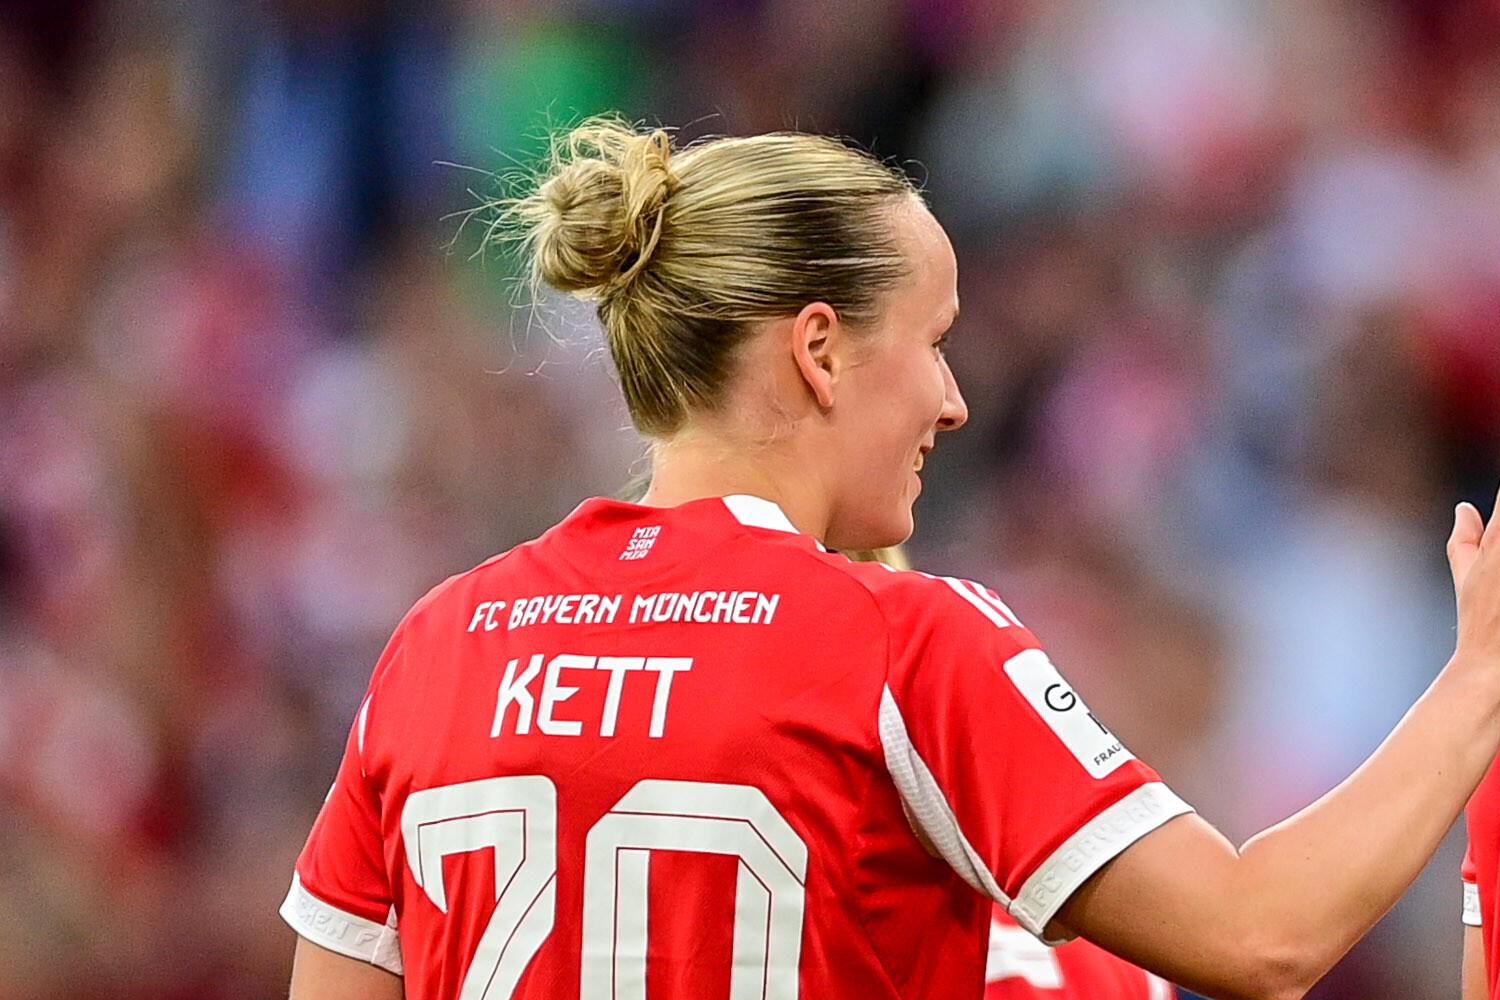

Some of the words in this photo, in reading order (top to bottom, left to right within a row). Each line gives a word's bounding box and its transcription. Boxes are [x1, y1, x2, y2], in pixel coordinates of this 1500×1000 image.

[632, 525, 662, 539] MIA
[626, 538, 656, 551] SAN
[618, 550, 649, 561] MIA
[467, 600, 507, 633] FC
[508, 593, 623, 631] BAYERN
[628, 590, 781, 625] MÜNCHEN
[489, 653, 694, 739] KETT
